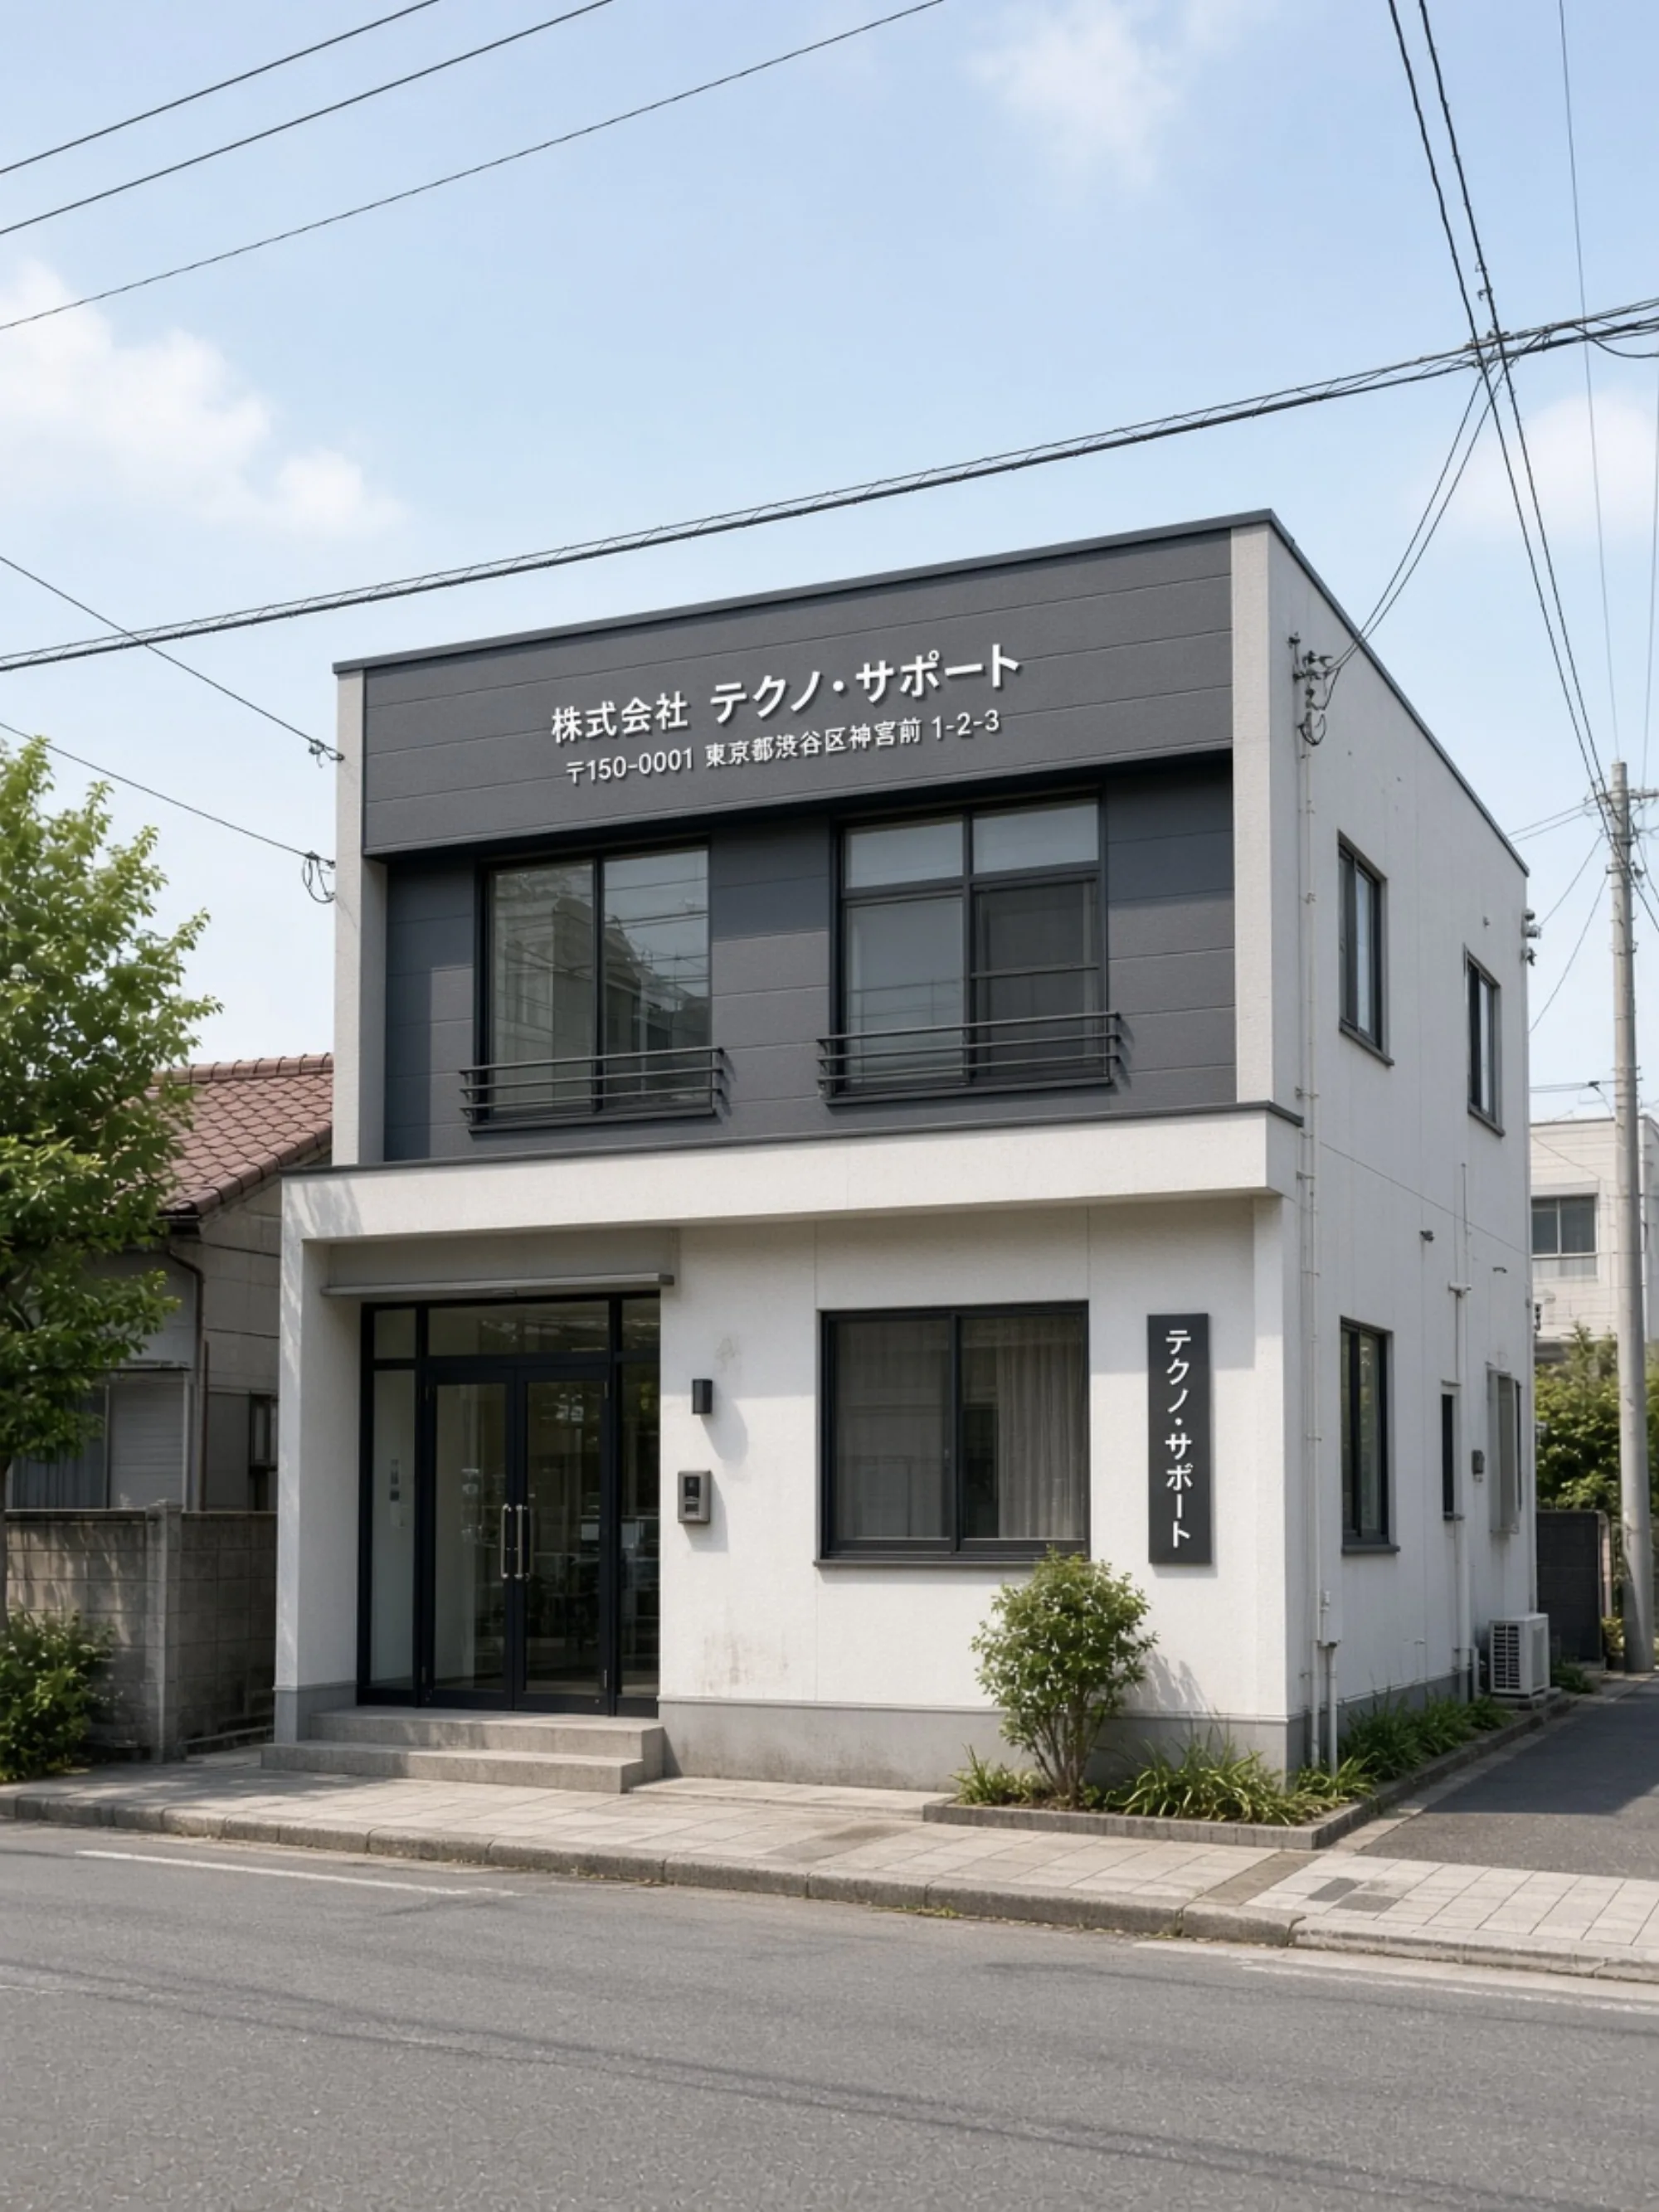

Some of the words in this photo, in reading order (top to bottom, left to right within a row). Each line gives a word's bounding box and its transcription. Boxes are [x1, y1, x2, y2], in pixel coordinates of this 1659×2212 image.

[551, 690, 688, 744] 株式会社
[709, 644, 1020, 724] テクノ・サポート
[566, 748, 693, 783] 〒150-0001
[704, 718, 921, 768] 東京都渋谷区神宮前
[932, 709, 1000, 739] 1-2-3
